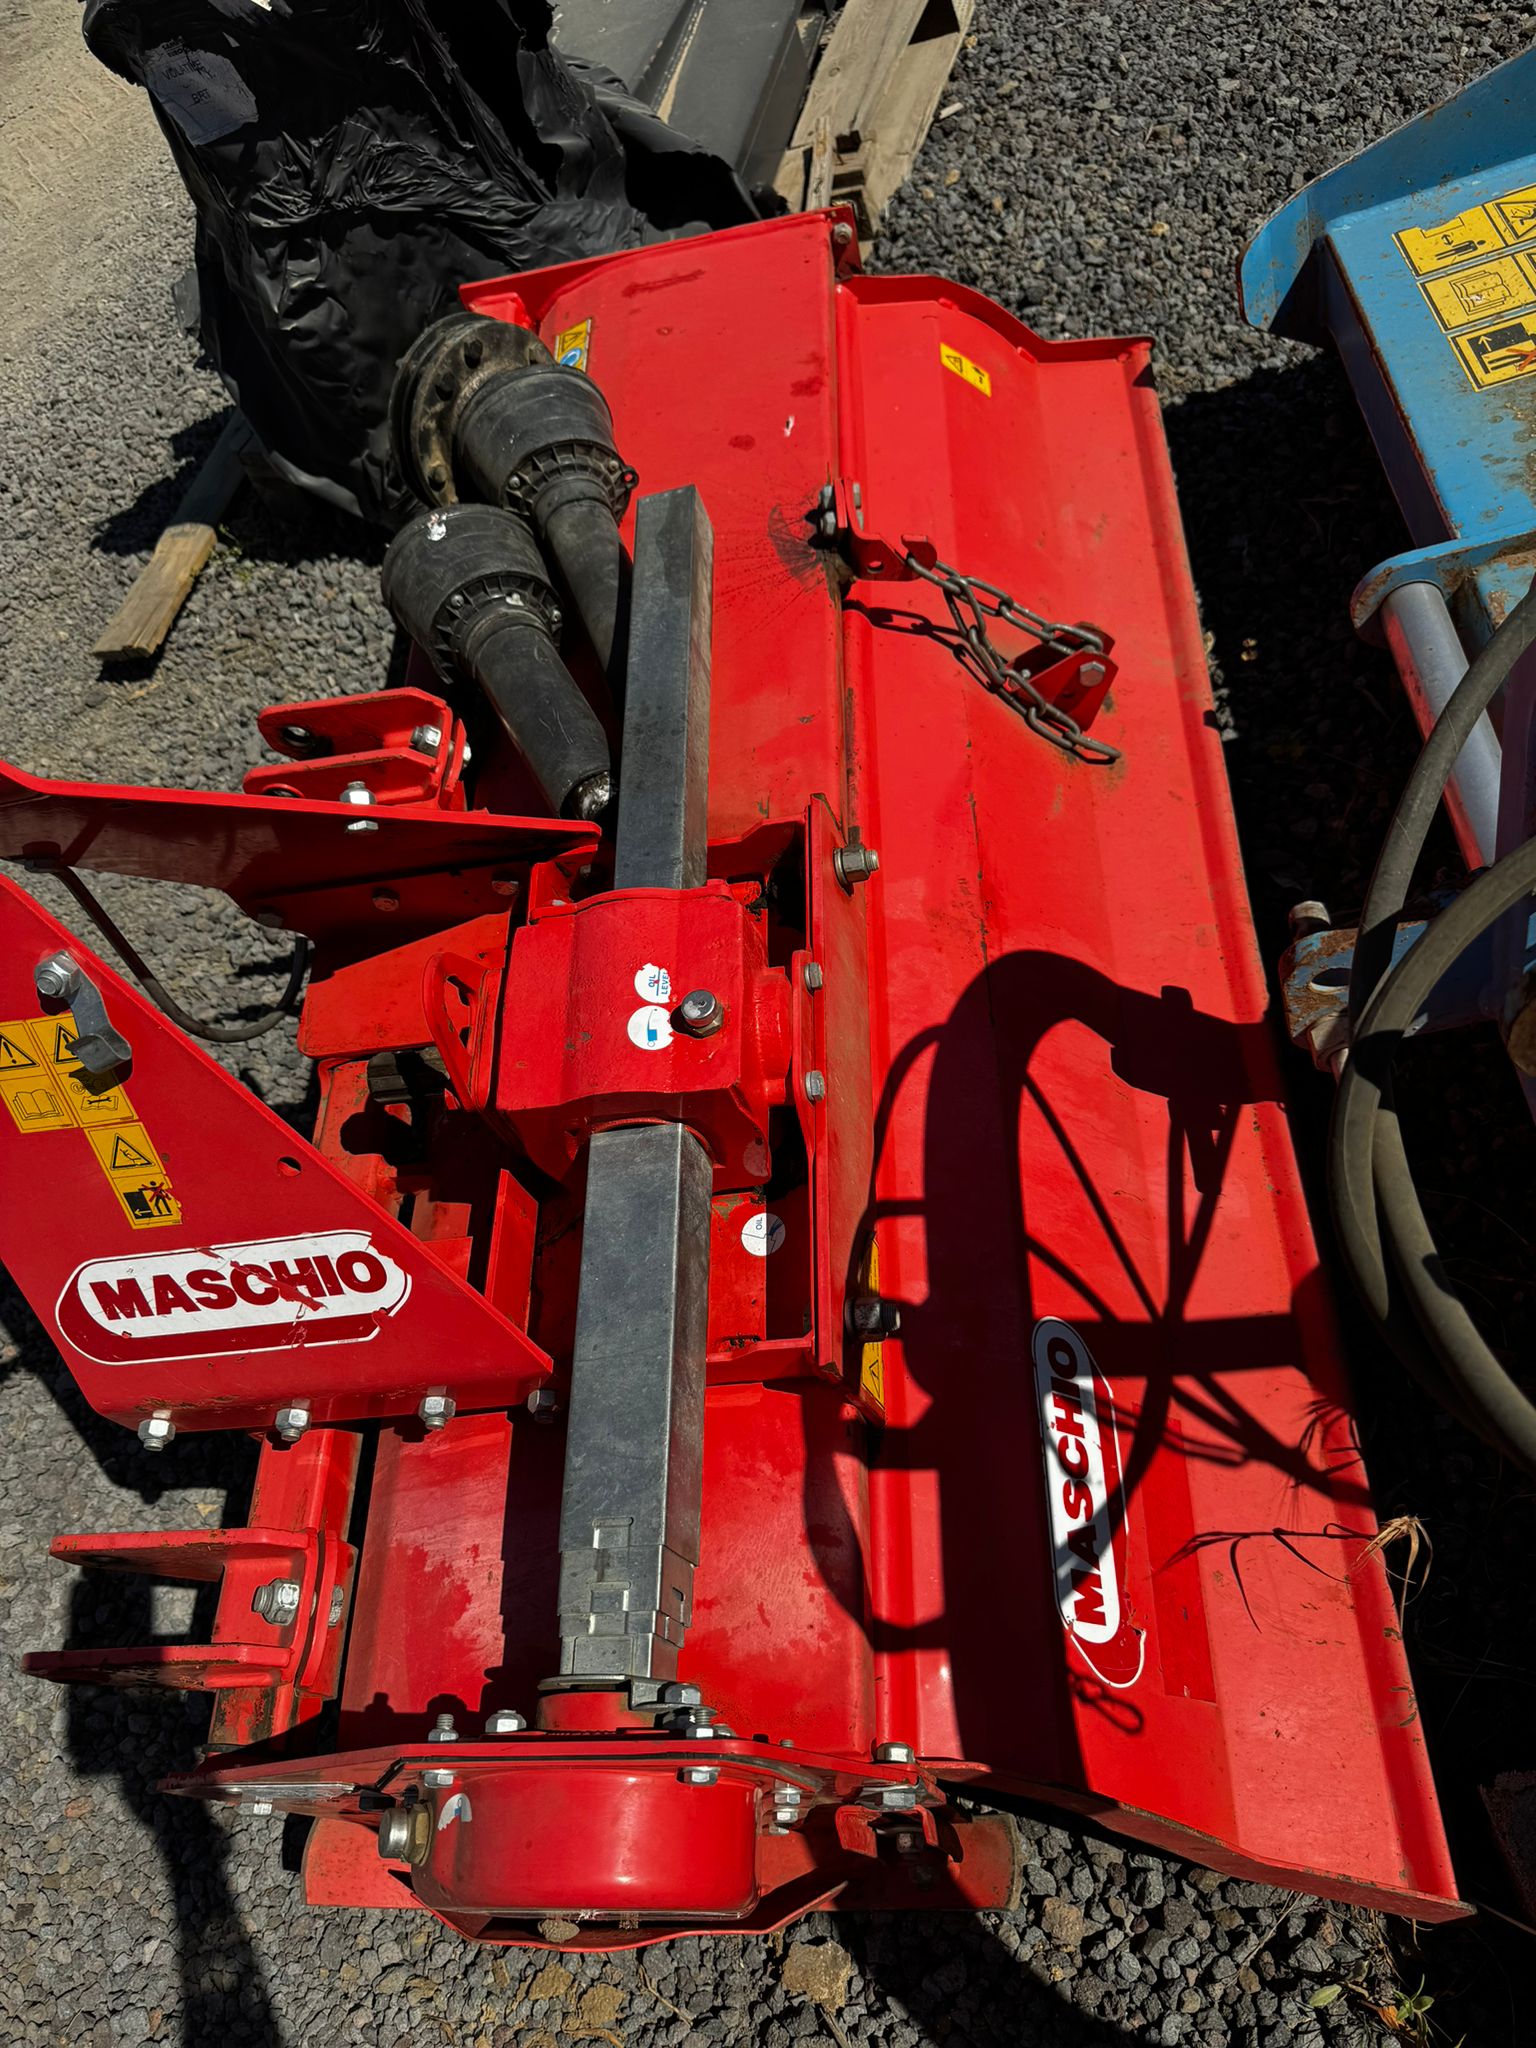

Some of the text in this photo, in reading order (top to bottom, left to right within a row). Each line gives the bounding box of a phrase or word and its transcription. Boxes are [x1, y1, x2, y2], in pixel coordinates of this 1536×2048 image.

[648, 974, 657, 988] OIL
[89, 1250, 388, 1321] MASCHIO
[1047, 1337, 1107, 1627] MASCHIO
